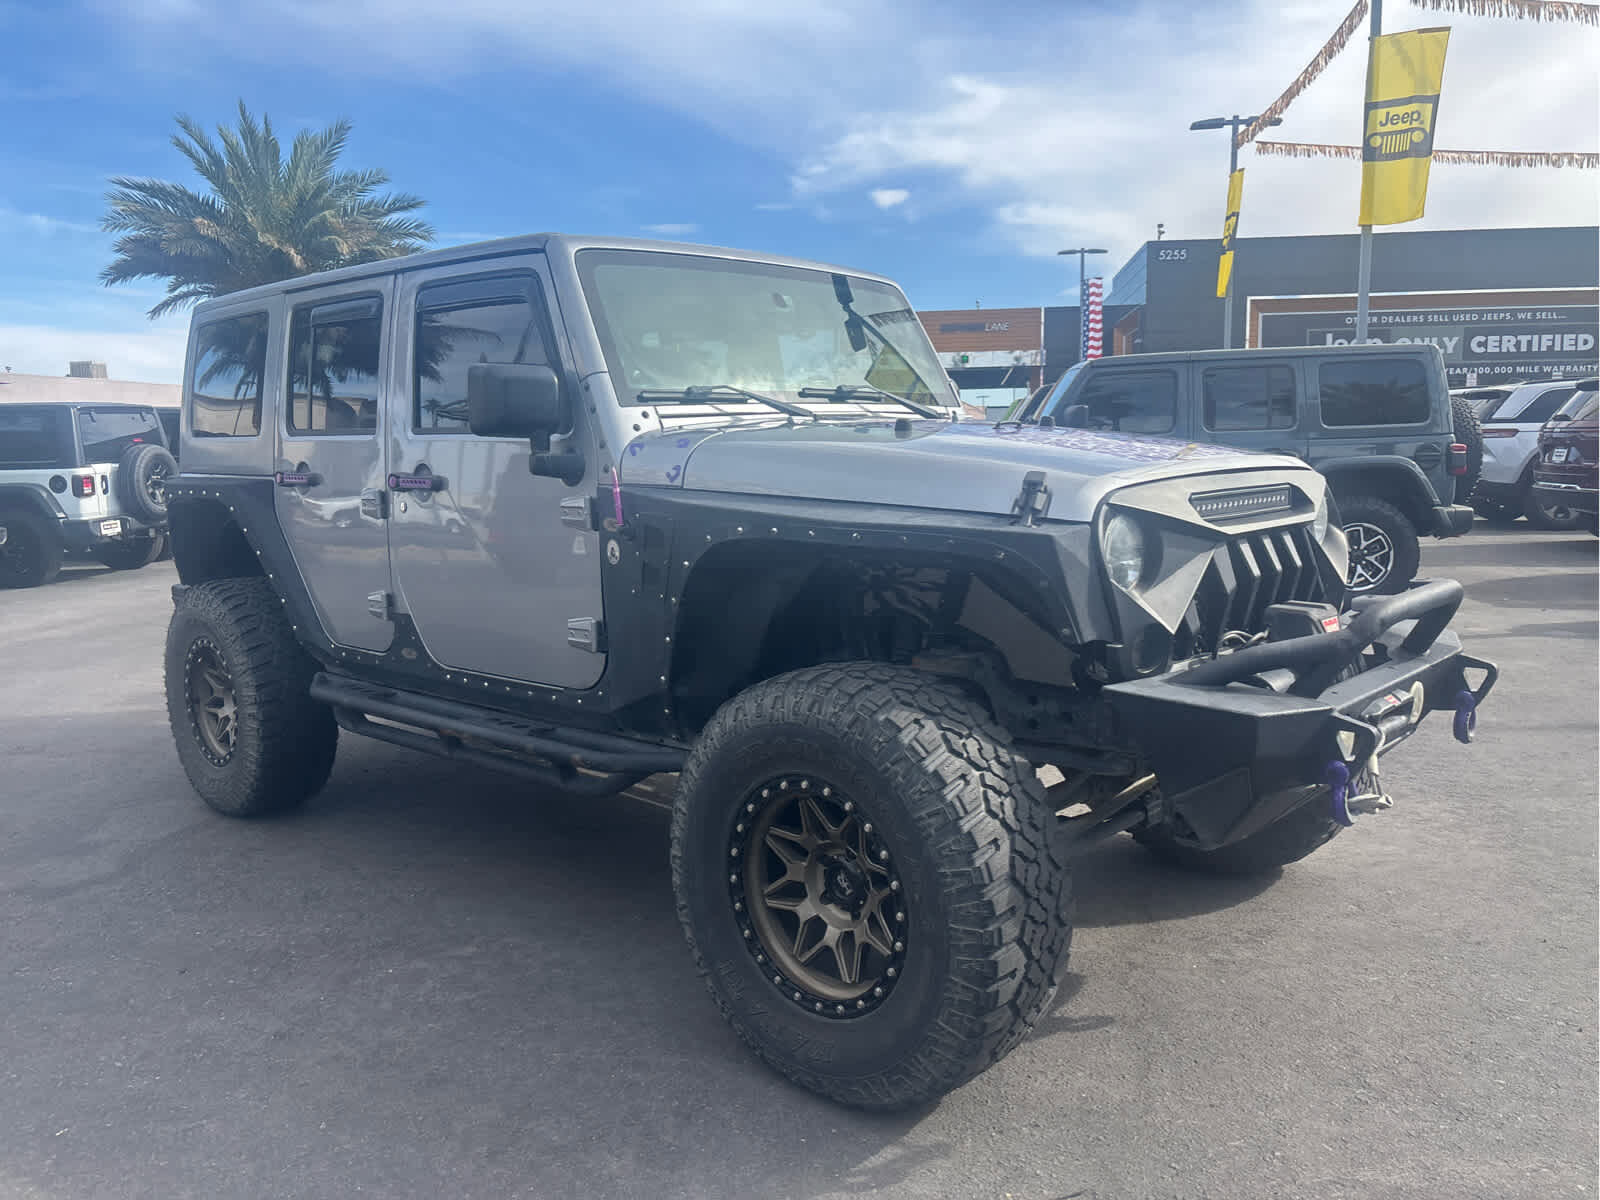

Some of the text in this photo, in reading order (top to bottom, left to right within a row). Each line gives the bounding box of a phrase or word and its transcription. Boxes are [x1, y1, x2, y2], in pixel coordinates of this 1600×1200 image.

[1379, 110, 1421, 127] Jeep
[1159, 248, 1187, 260] 5255
[1345, 315, 1378, 324] OTER
[1381, 314, 1424, 324] DEALERS
[1427, 313, 1449, 322] SELL
[1452, 313, 1479, 321] USED
[1481, 312, 1514, 321] JEEPS,
[1517, 312, 1532, 320] WE
[984, 321, 1009, 332] LANE
[1470, 333, 1595, 354] CERTIFIED
[1516, 365, 1540, 373] MILE
[1543, 364, 1598, 373] WARRANTY
